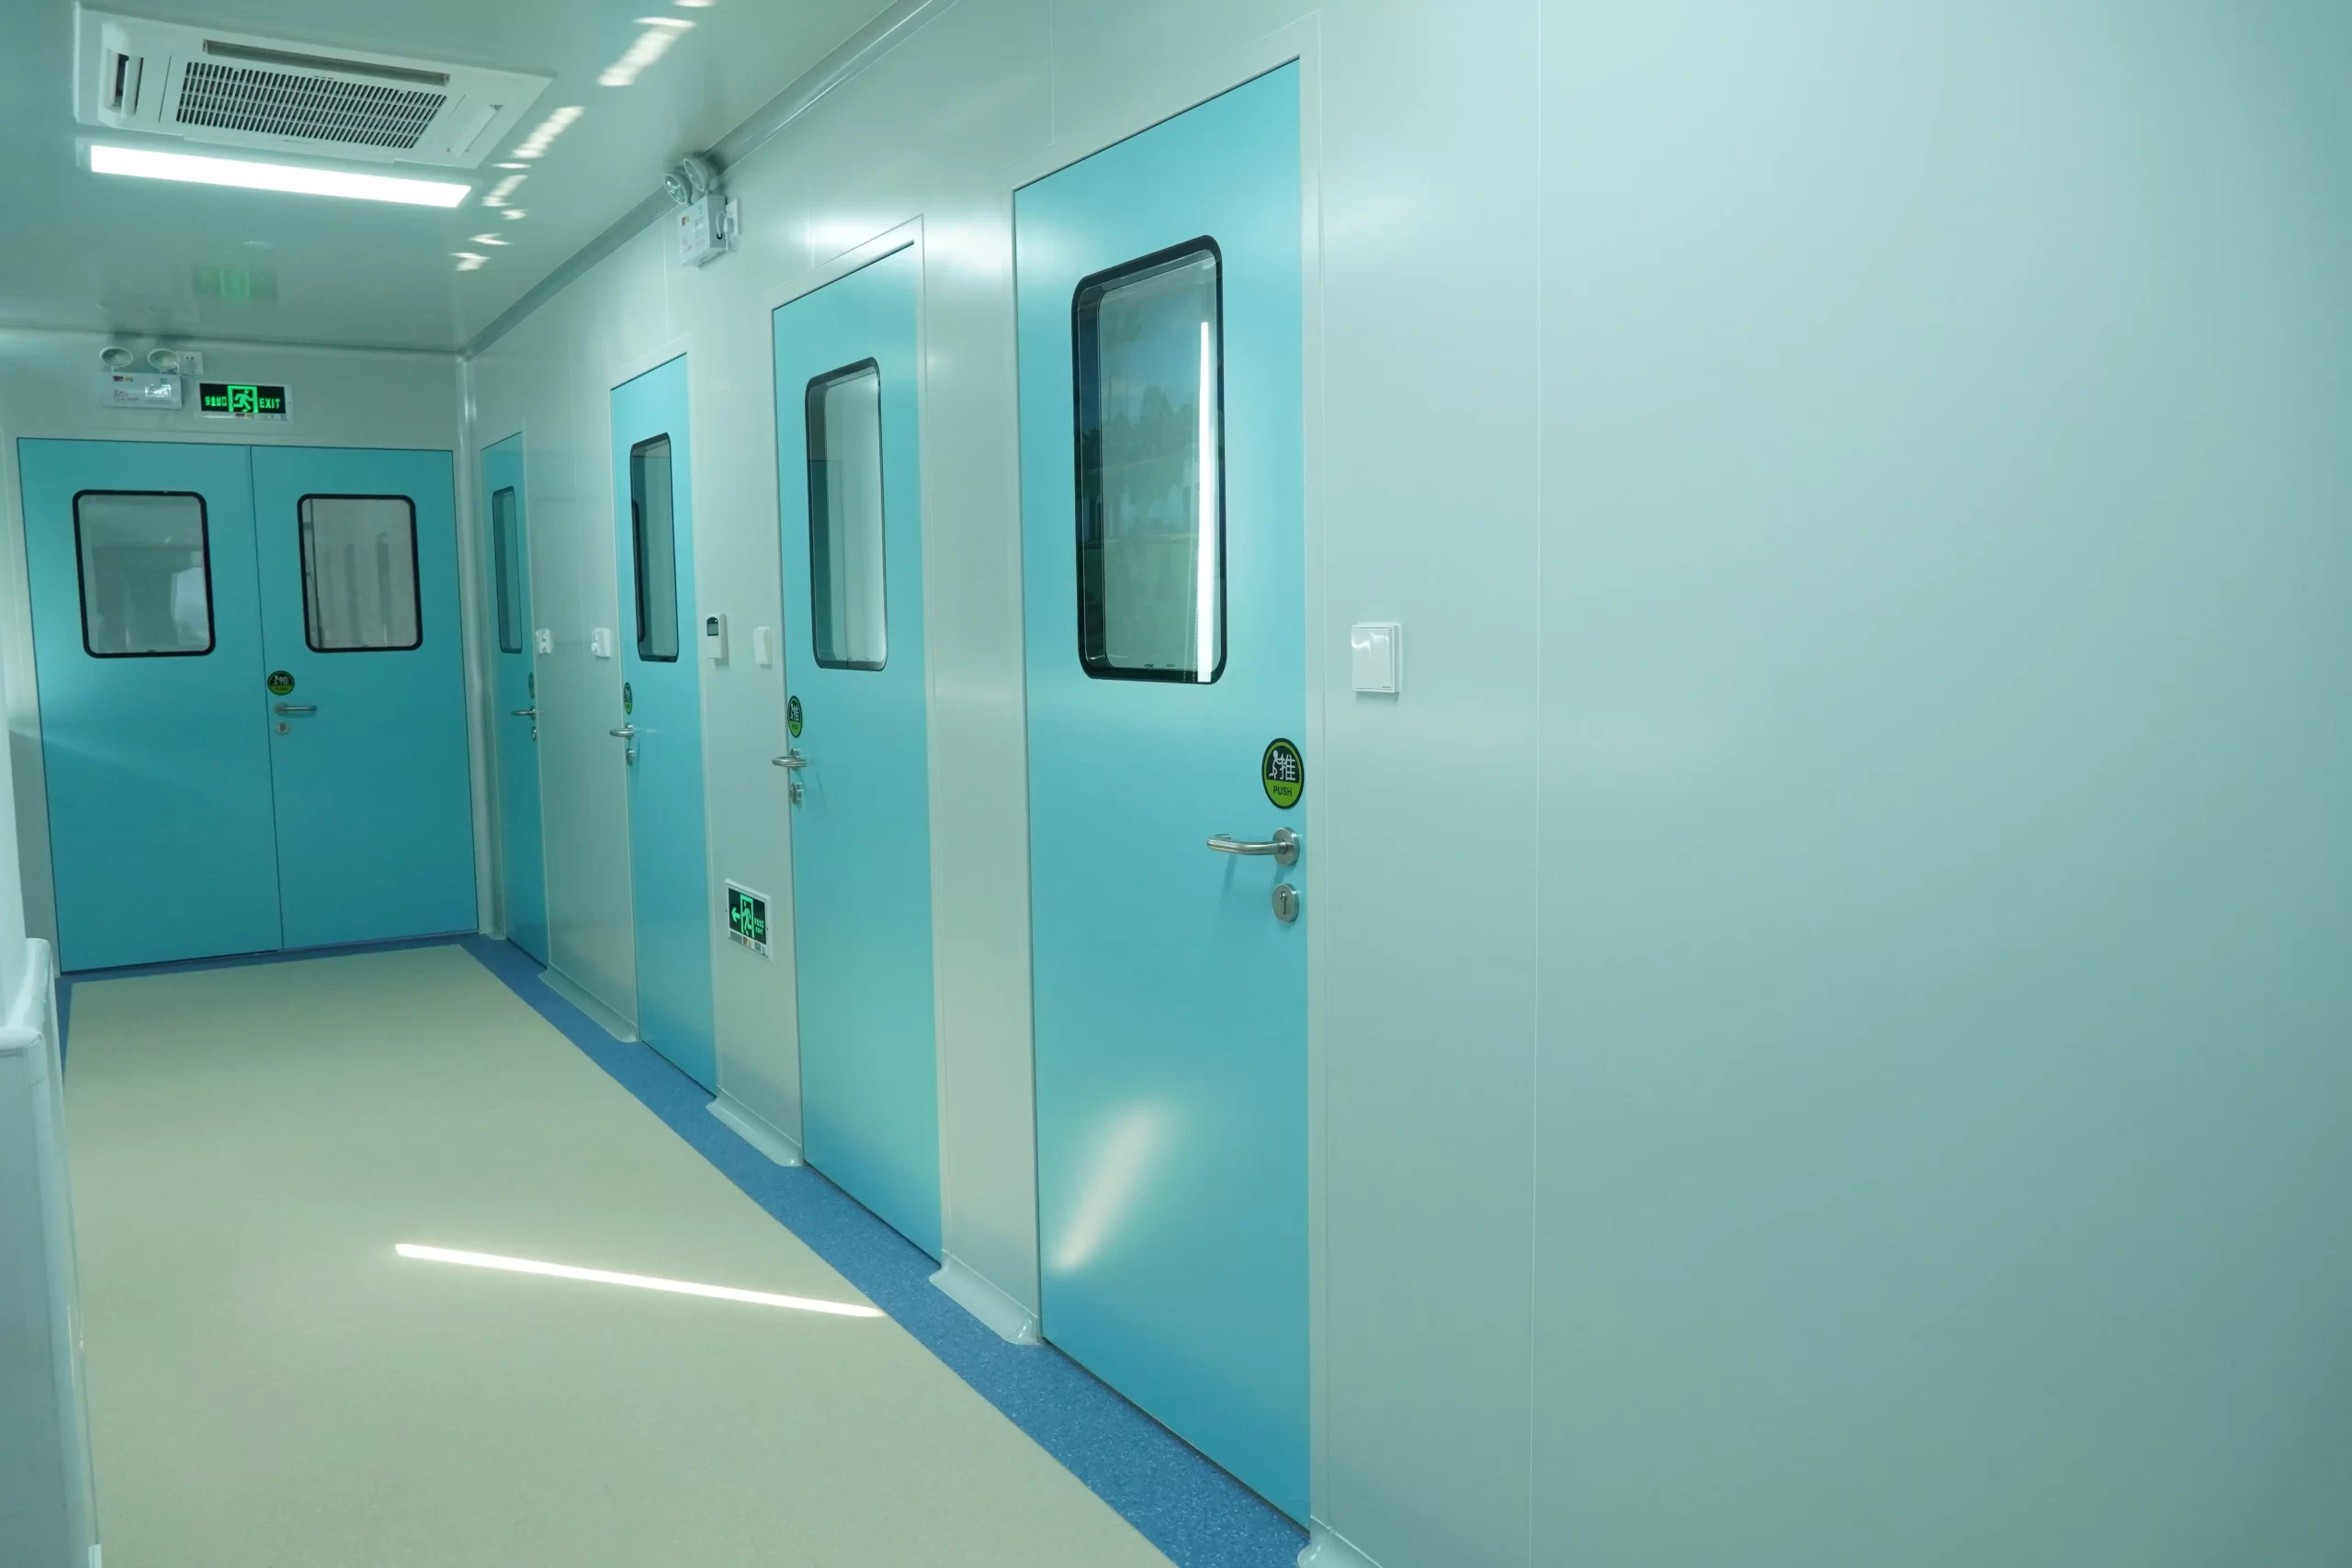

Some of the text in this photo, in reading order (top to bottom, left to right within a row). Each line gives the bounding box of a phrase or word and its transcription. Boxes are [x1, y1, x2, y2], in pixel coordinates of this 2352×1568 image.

[259, 398, 280, 409] EXIT
[1280, 753, 1296, 781] 推
[1273, 785, 1293, 797] PUSH
